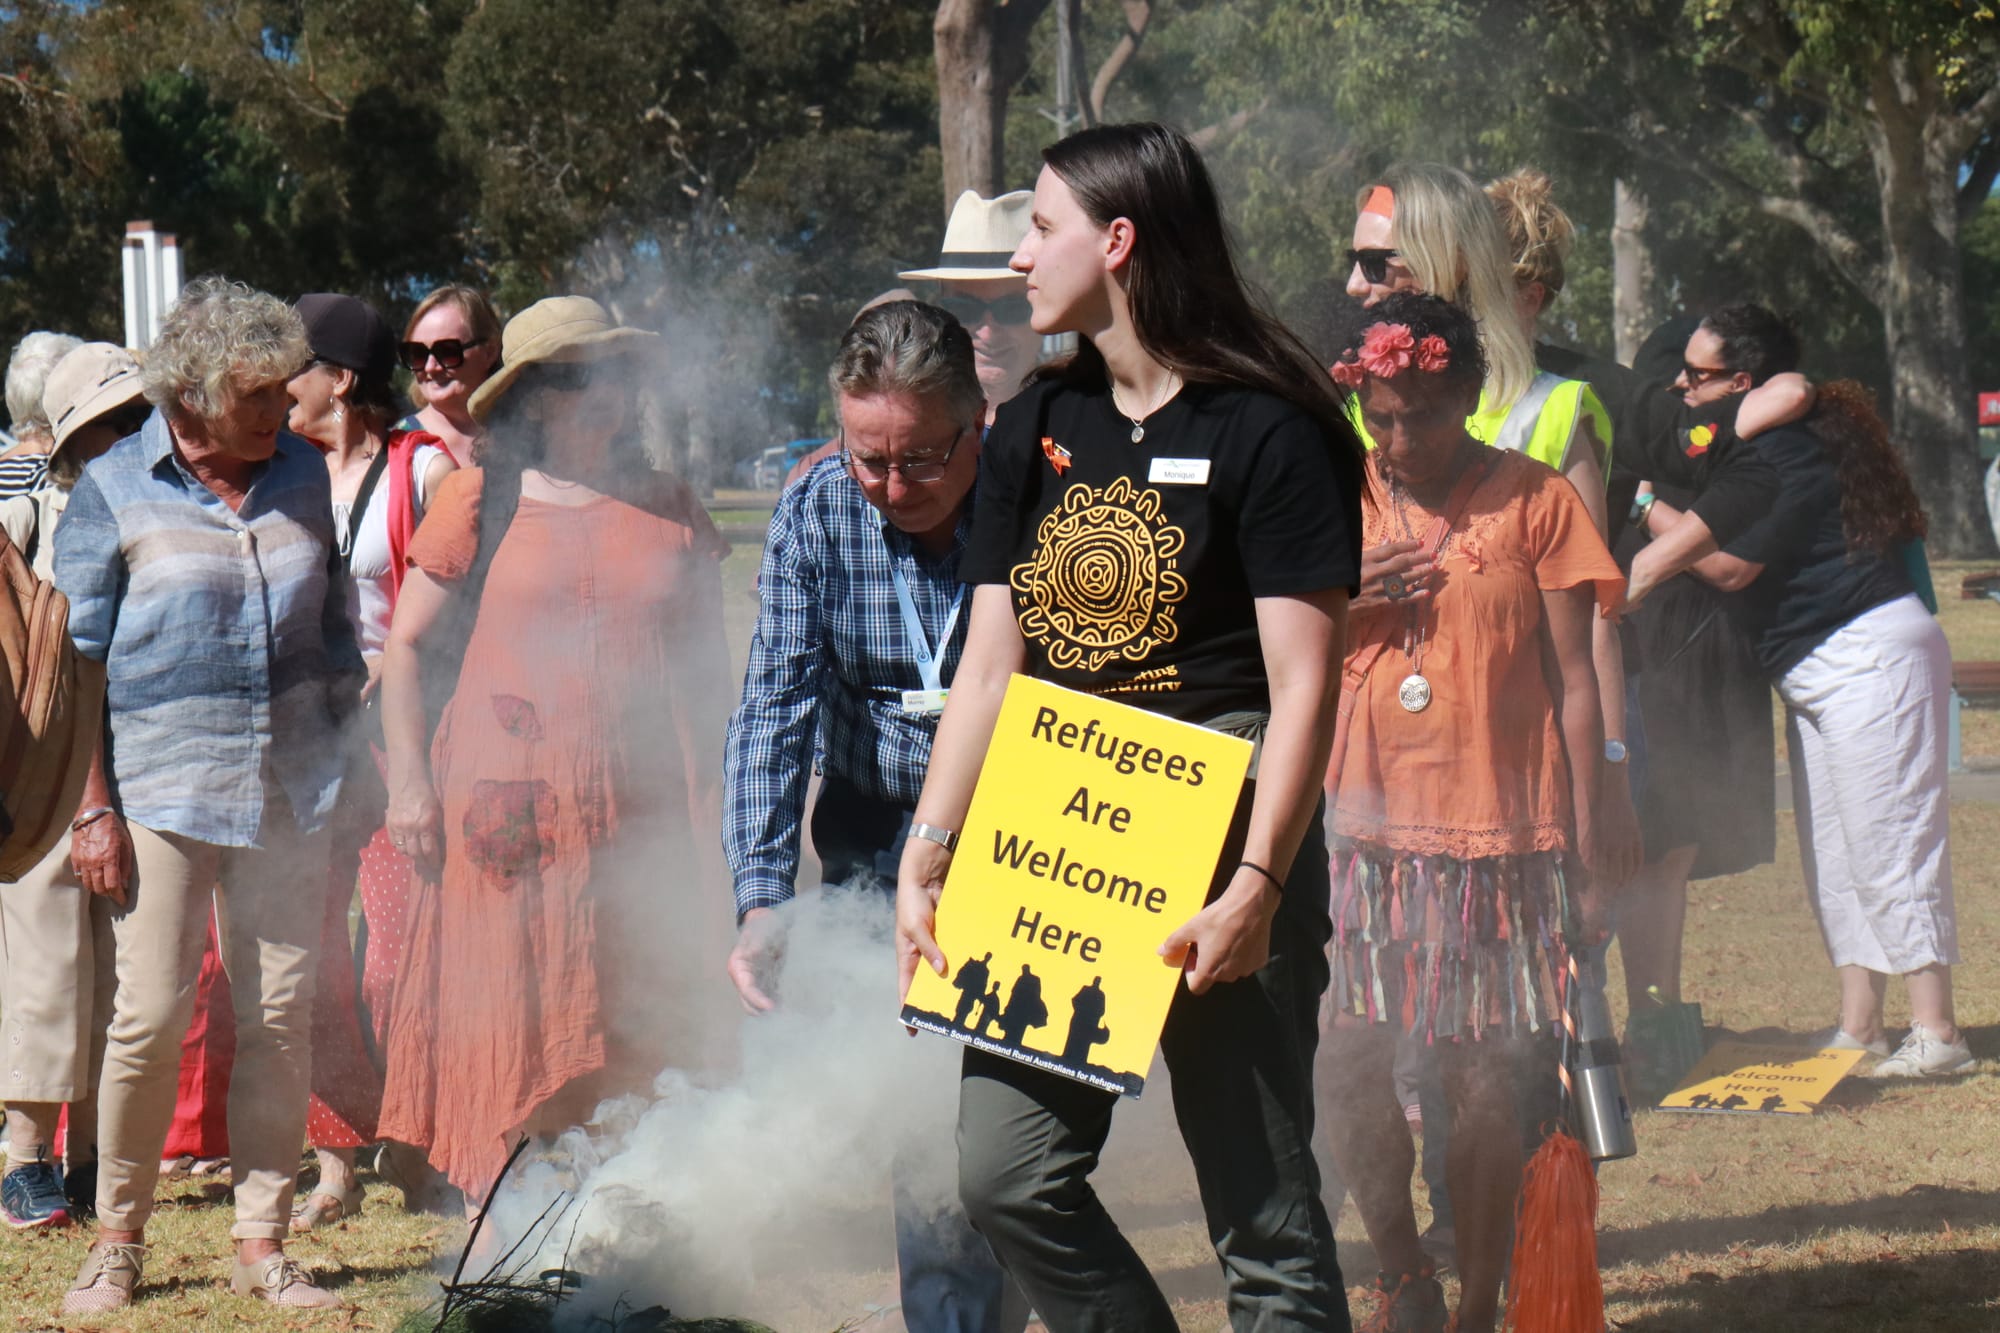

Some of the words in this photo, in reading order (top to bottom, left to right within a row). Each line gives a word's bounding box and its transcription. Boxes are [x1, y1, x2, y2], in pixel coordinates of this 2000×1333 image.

[1164, 471, 1195, 481] Monique
[1031, 706, 1207, 787] Refugees
[1062, 786, 1132, 833] Are
[993, 829, 1168, 914] Welcome
[1010, 906, 1103, 963] Here
[911, 1016, 949, 1036] Facebook:
[950, 1029, 973, 1043] South
[973, 1037, 1012, 1056] Gippsland
[1012, 1049, 1033, 1062] Rural
[1033, 1056, 1076, 1077] Australians
[1076, 1070, 1089, 1080] for
[1089, 1074, 1125, 1093] Refugees
[1724, 1082, 1780, 1093] Here
